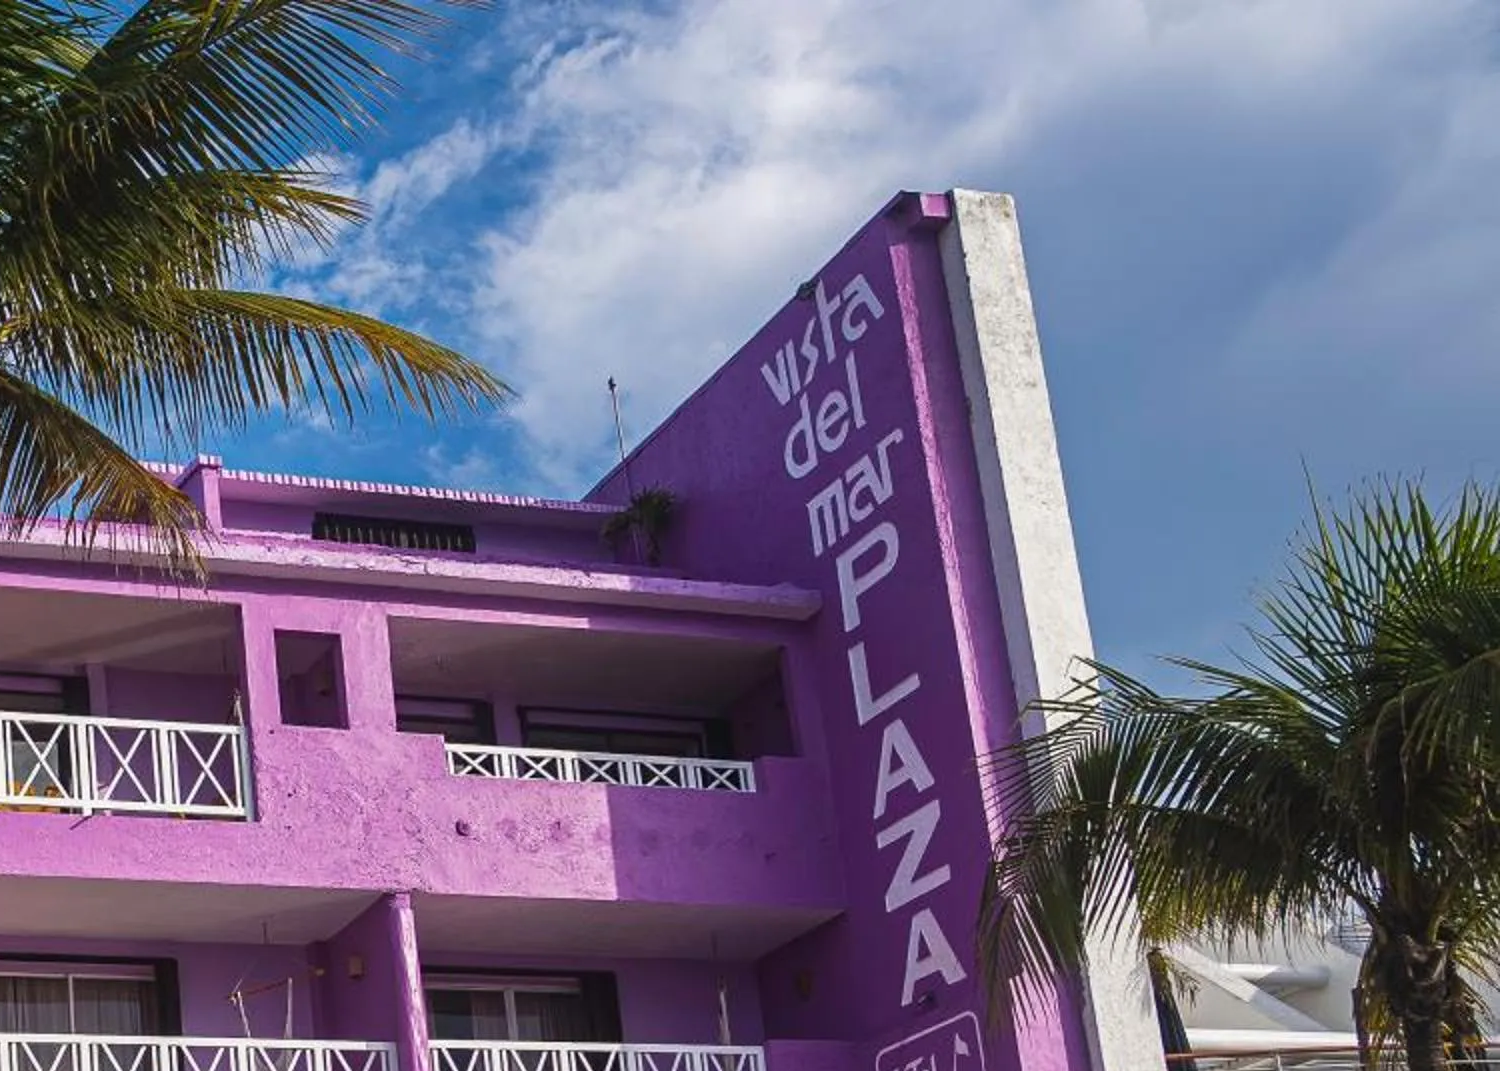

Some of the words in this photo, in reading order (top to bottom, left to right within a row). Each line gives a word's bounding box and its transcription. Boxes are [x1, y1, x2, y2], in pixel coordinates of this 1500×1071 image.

[760, 274, 884, 406] vista
[784, 350, 867, 479] del
[806, 429, 903, 557] mar
[835, 522, 967, 1007] PLAZA
